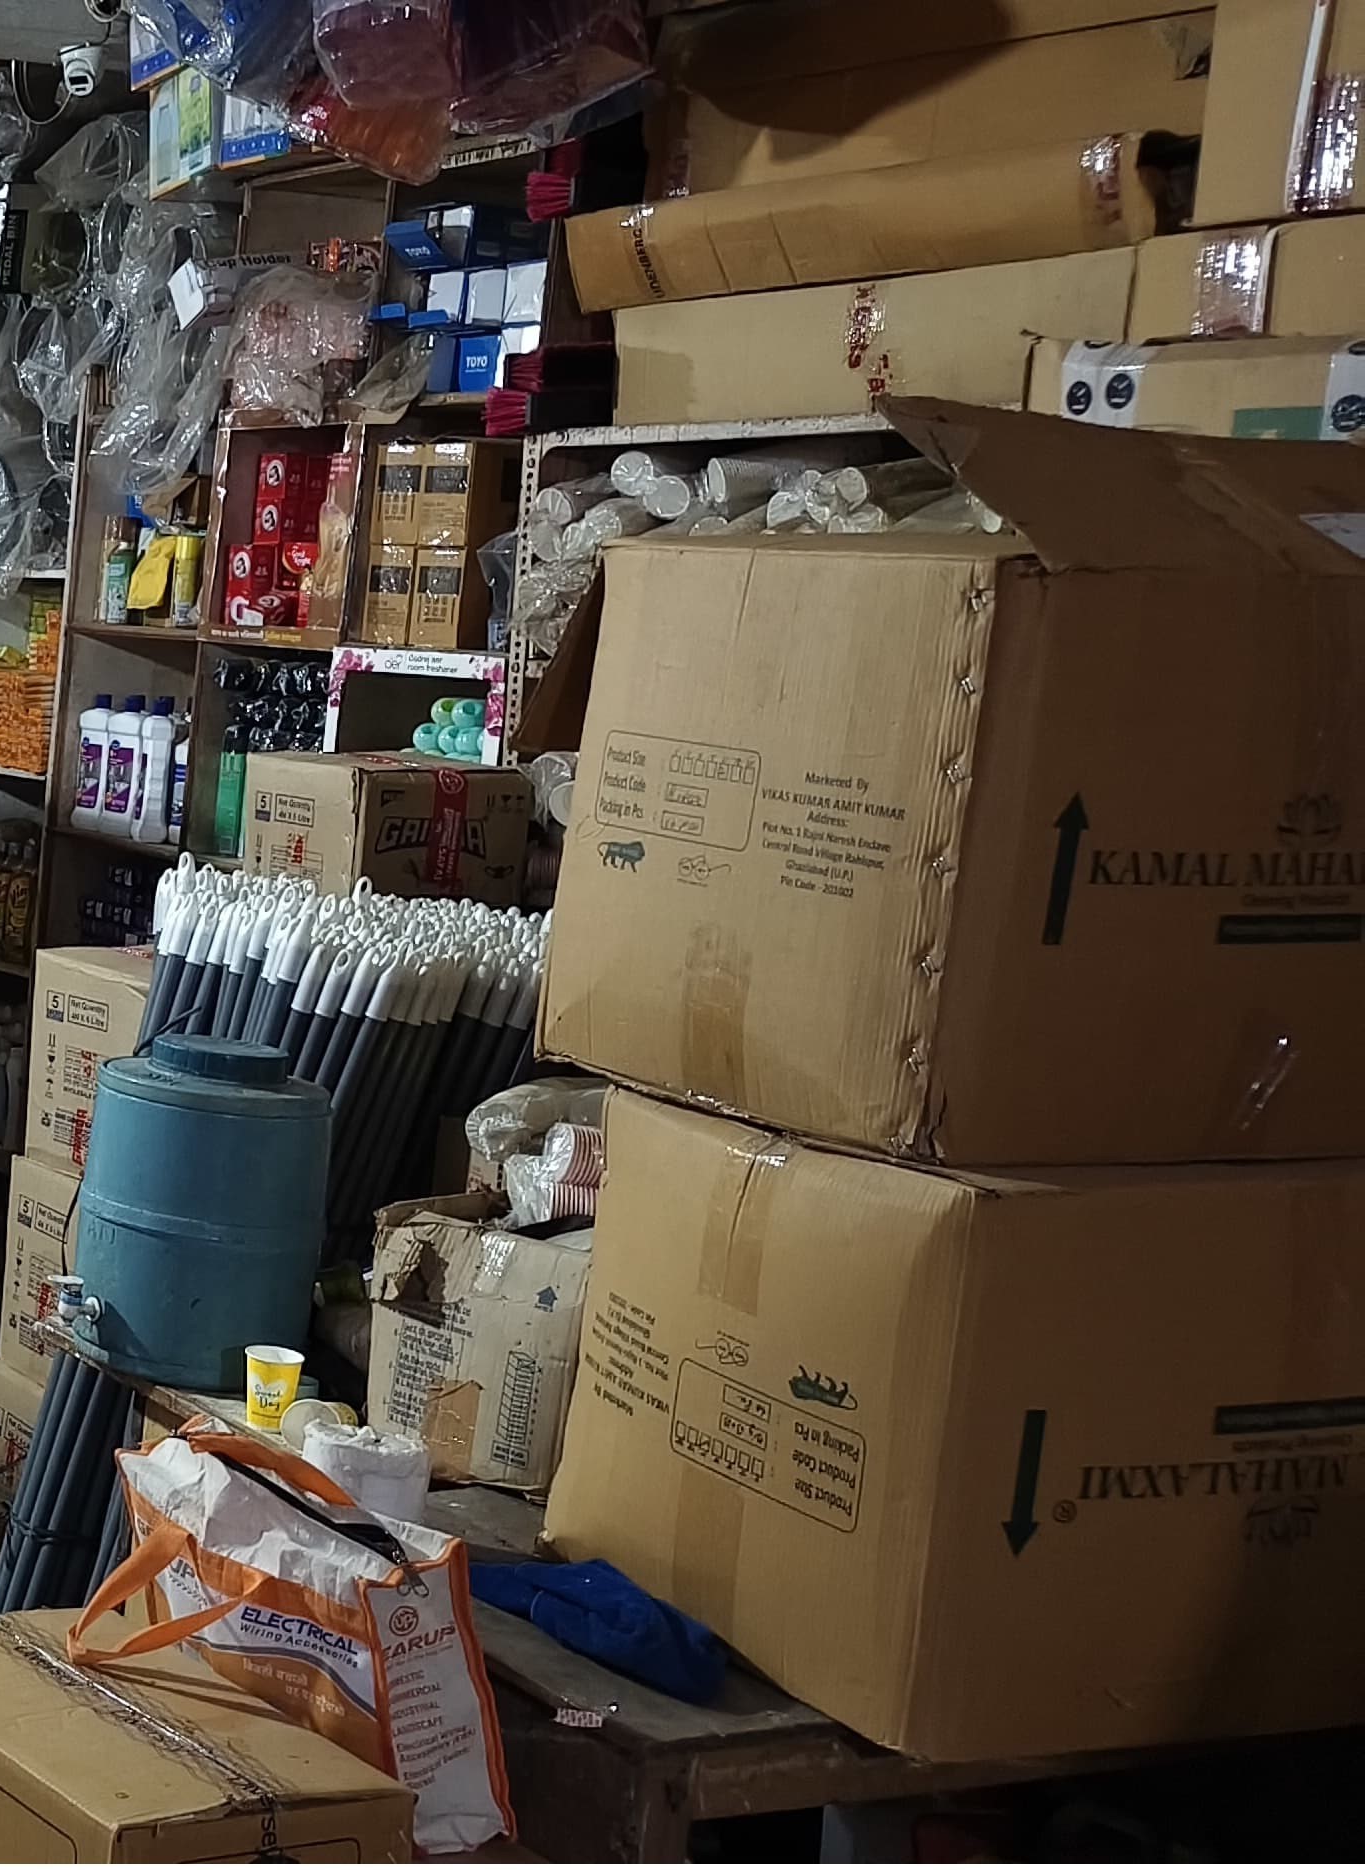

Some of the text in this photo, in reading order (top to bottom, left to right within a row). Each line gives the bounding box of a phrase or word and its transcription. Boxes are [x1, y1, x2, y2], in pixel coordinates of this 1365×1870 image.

[240, 253, 291, 267] Holder
[466, 356, 488, 369] TOYO
[607, 747, 632, 763] Product
[604, 771, 646, 793] Product Code
[805, 772, 870, 795] Marketed By
[260, 795, 267, 808] 5
[600, 796, 623, 818] Packing
[762, 788, 906, 821] VIKAS KUMAR AMIT KUMAR
[762, 821, 778, 832] Plot
[806, 811, 849, 827] Address:
[830, 866, 854, 883] (U.P.)
[1089, 850, 1237, 887] KAMAL
[780, 875, 794, 887] Pin
[795, 878, 817, 891] Code
[53, 996, 59, 1009] 5
[70, 1000, 107, 1019] Net Quantity
[23, 1200, 30, 1214] 5
[600, 1367, 670, 1414] VIKAS AMIT
[822, 1430, 860, 1463] Packing
[792, 1449, 816, 1472] Code
[1078, 1453, 1350, 1501] MAHALAXMI
[240, 1605, 359, 1656] ELECTRICAL
[239, 1622, 359, 1669] Wiring Accessories
